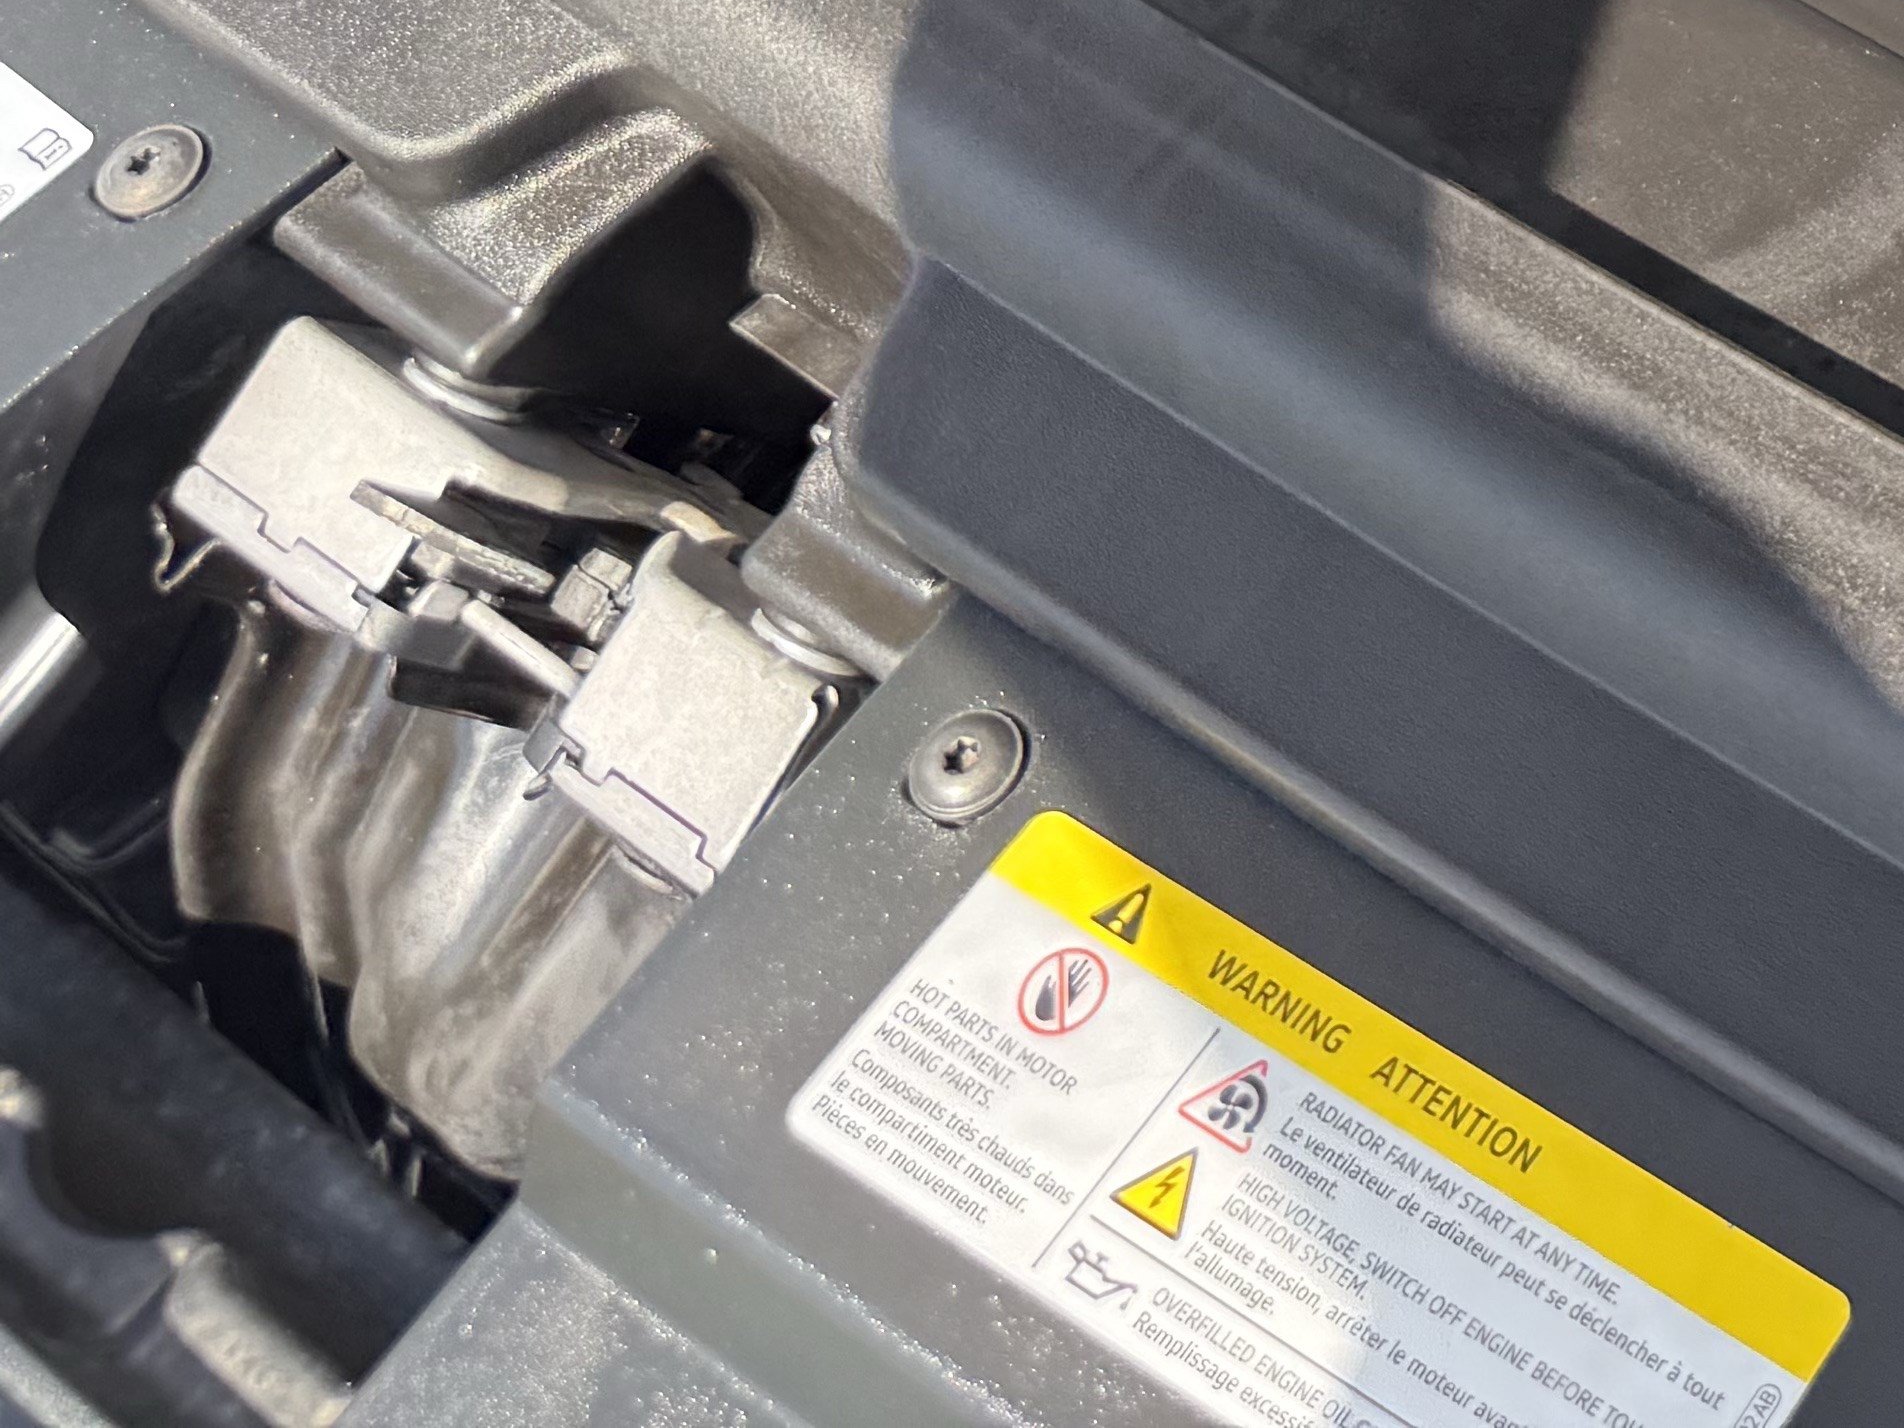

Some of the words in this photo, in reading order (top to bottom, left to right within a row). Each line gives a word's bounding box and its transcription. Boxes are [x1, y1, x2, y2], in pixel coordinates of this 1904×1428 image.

[873, 1021, 944, 1074] MOVING
[939, 1063, 995, 1110] PARTS.
[892, 1000, 1016, 1090] COMPARTMENT.
[909, 978, 950, 1009] HOT
[944, 1000, 999, 1043] PARTS
[994, 1034, 1018, 1057] IN
[1015, 1047, 1078, 1096] MOTOR
[1208, 949, 1352, 1054] WARNING
[1369, 1056, 1543, 1174] ATTENTION
[811, 1094, 866, 1140] Pièces
[864, 1134, 888, 1156] en
[886, 1148, 988, 1225] mouvement.
[830, 1070, 851, 1094] le
[848, 1087, 966, 1171] compartiment
[962, 1162, 1027, 1214] moteur.
[851, 1048, 948, 1122] Composants
[944, 1112, 980, 1143] très
[976, 1135, 1035, 1179] chauds
[1033, 1173, 1074, 1206] dans
[1262, 1143, 1339, 1201] moment.
[1221, 1194, 1302, 1254] IGNITION
[1298, 1244, 1369, 1301] SYSTEM.
[1279, 1116, 1304, 1144] Le
[1303, 1134, 1398, 1201] ventilateur
[1393, 1187, 1428, 1219] de
[1419, 1210, 1503, 1268] radiateur
[1497, 1261, 1546, 1297] peut
[1544, 1289, 1568, 1311] se
[1568, 1302, 1669, 1373] déclencher
[1666, 1361, 1682, 1383] à
[1682, 1373, 1725, 1411] tout
[1299, 1091, 1386, 1155] RADIATOR
[1383, 1144, 1423, 1178] FAN
[1419, 1167, 1463, 1201] MAY
[1457, 1191, 1516, 1234] START
[1509, 1226, 1540, 1250] AT
[1533, 1241, 1577, 1273] ANY
[1574, 1262, 1621, 1306] TIME.
[1184, 1241, 1274, 1315] l'allumage.
[1200, 1219, 1255, 1267] Haute
[1254, 1257, 1321, 1315] tension,
[1325, 1306, 1390, 1352] arrêter
[1386, 1340, 1406, 1365] le
[1406, 1358, 1475, 1408] moteur
[1238, 1173, 1286, 1211] HIGH
[1284, 1200, 1361, 1265] VOLTAGE,
[1359, 1252, 1431, 1305] SWITCH
[1428, 1295, 1468, 1325] OFF
[1463, 1317, 1534, 1372] ENGINE
[1530, 1360, 1605, 1417] BEFORE
[1132, 1310, 1240, 1394] Remplissage
[1152, 1287, 1256, 1364] OVERFILLED
[1253, 1354, 1325, 1410] ENGINE
[1317, 1396, 1359, 1428] OIL
